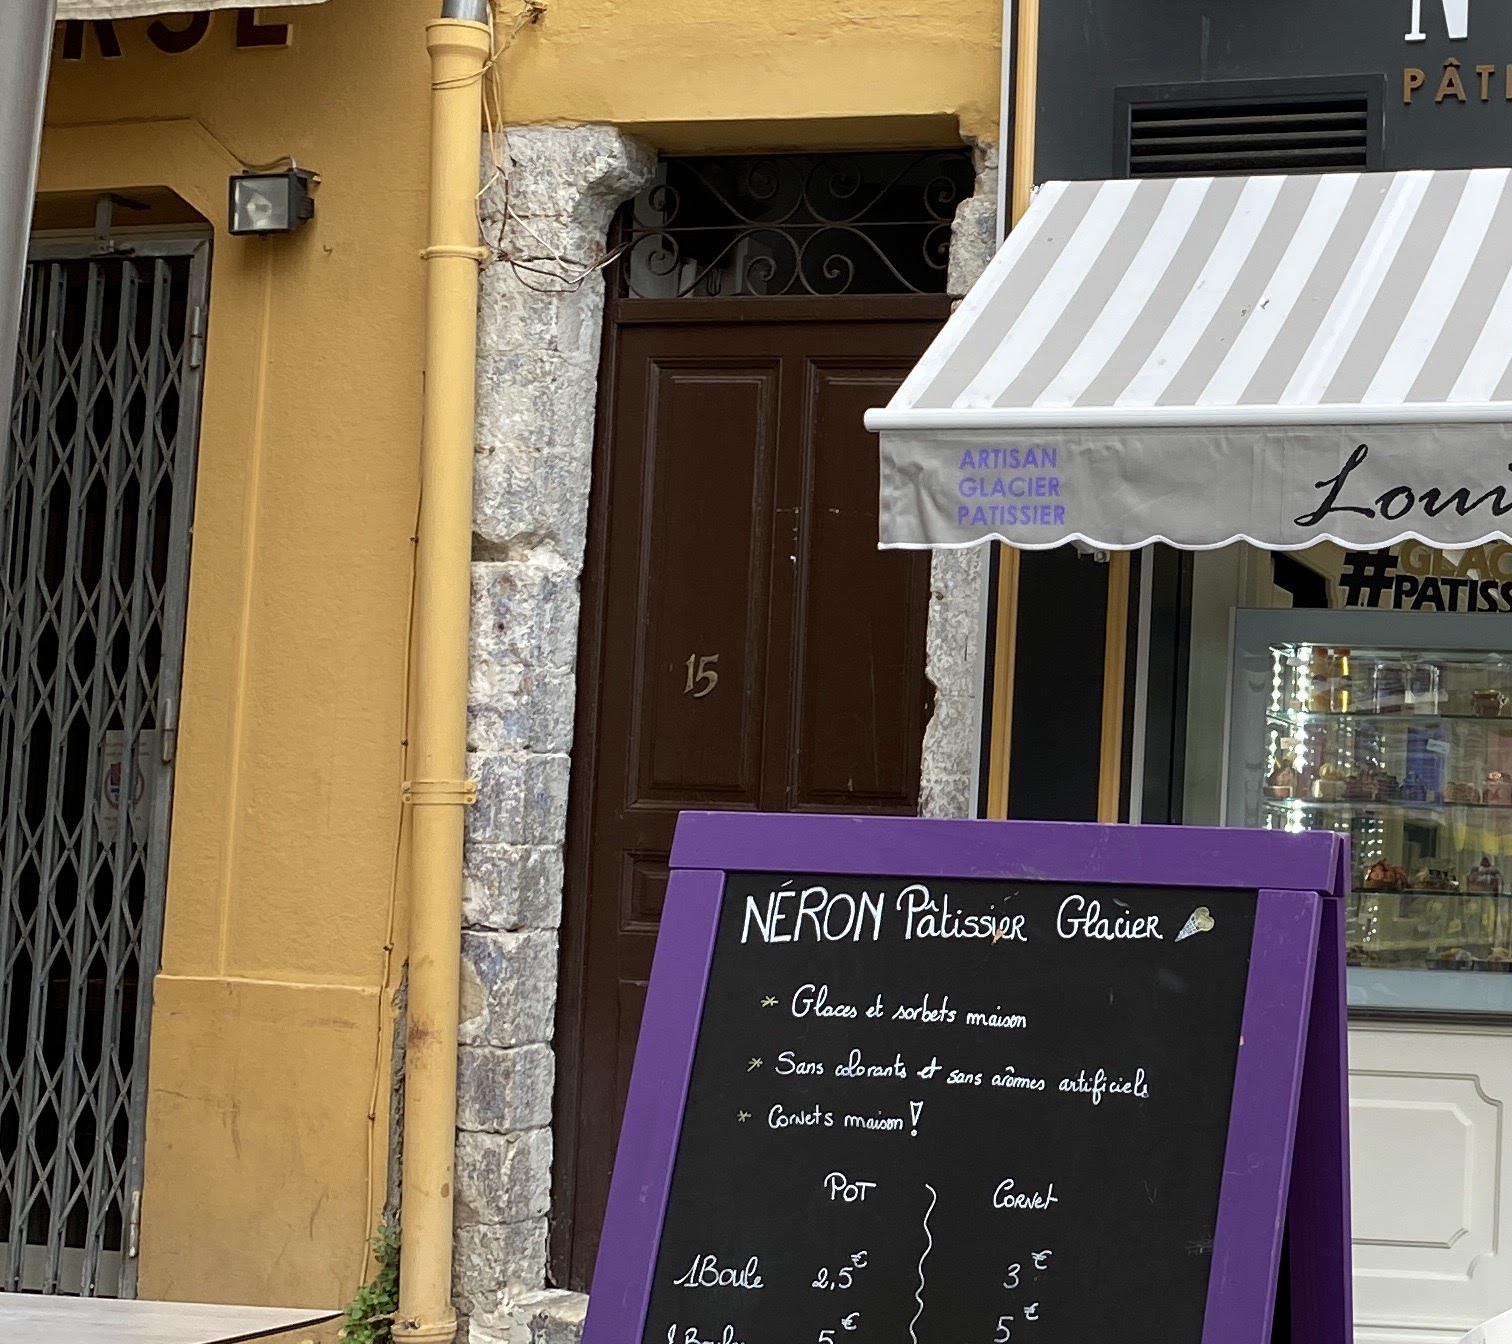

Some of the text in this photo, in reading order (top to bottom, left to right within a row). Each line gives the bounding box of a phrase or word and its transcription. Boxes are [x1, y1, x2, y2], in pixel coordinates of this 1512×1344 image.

[959, 447, 1057, 470] ARTISAN
[959, 477, 1060, 498] GLACIER
[957, 504, 1065, 526] PATISSIER
[684, 654, 719, 698] 15
[741, 880, 884, 944] NÉRON
[792, 984, 1027, 1028] Glaces et sorbets maison
[775, 1049, 1149, 1105] Sans colorants et sans arômes artificiels
